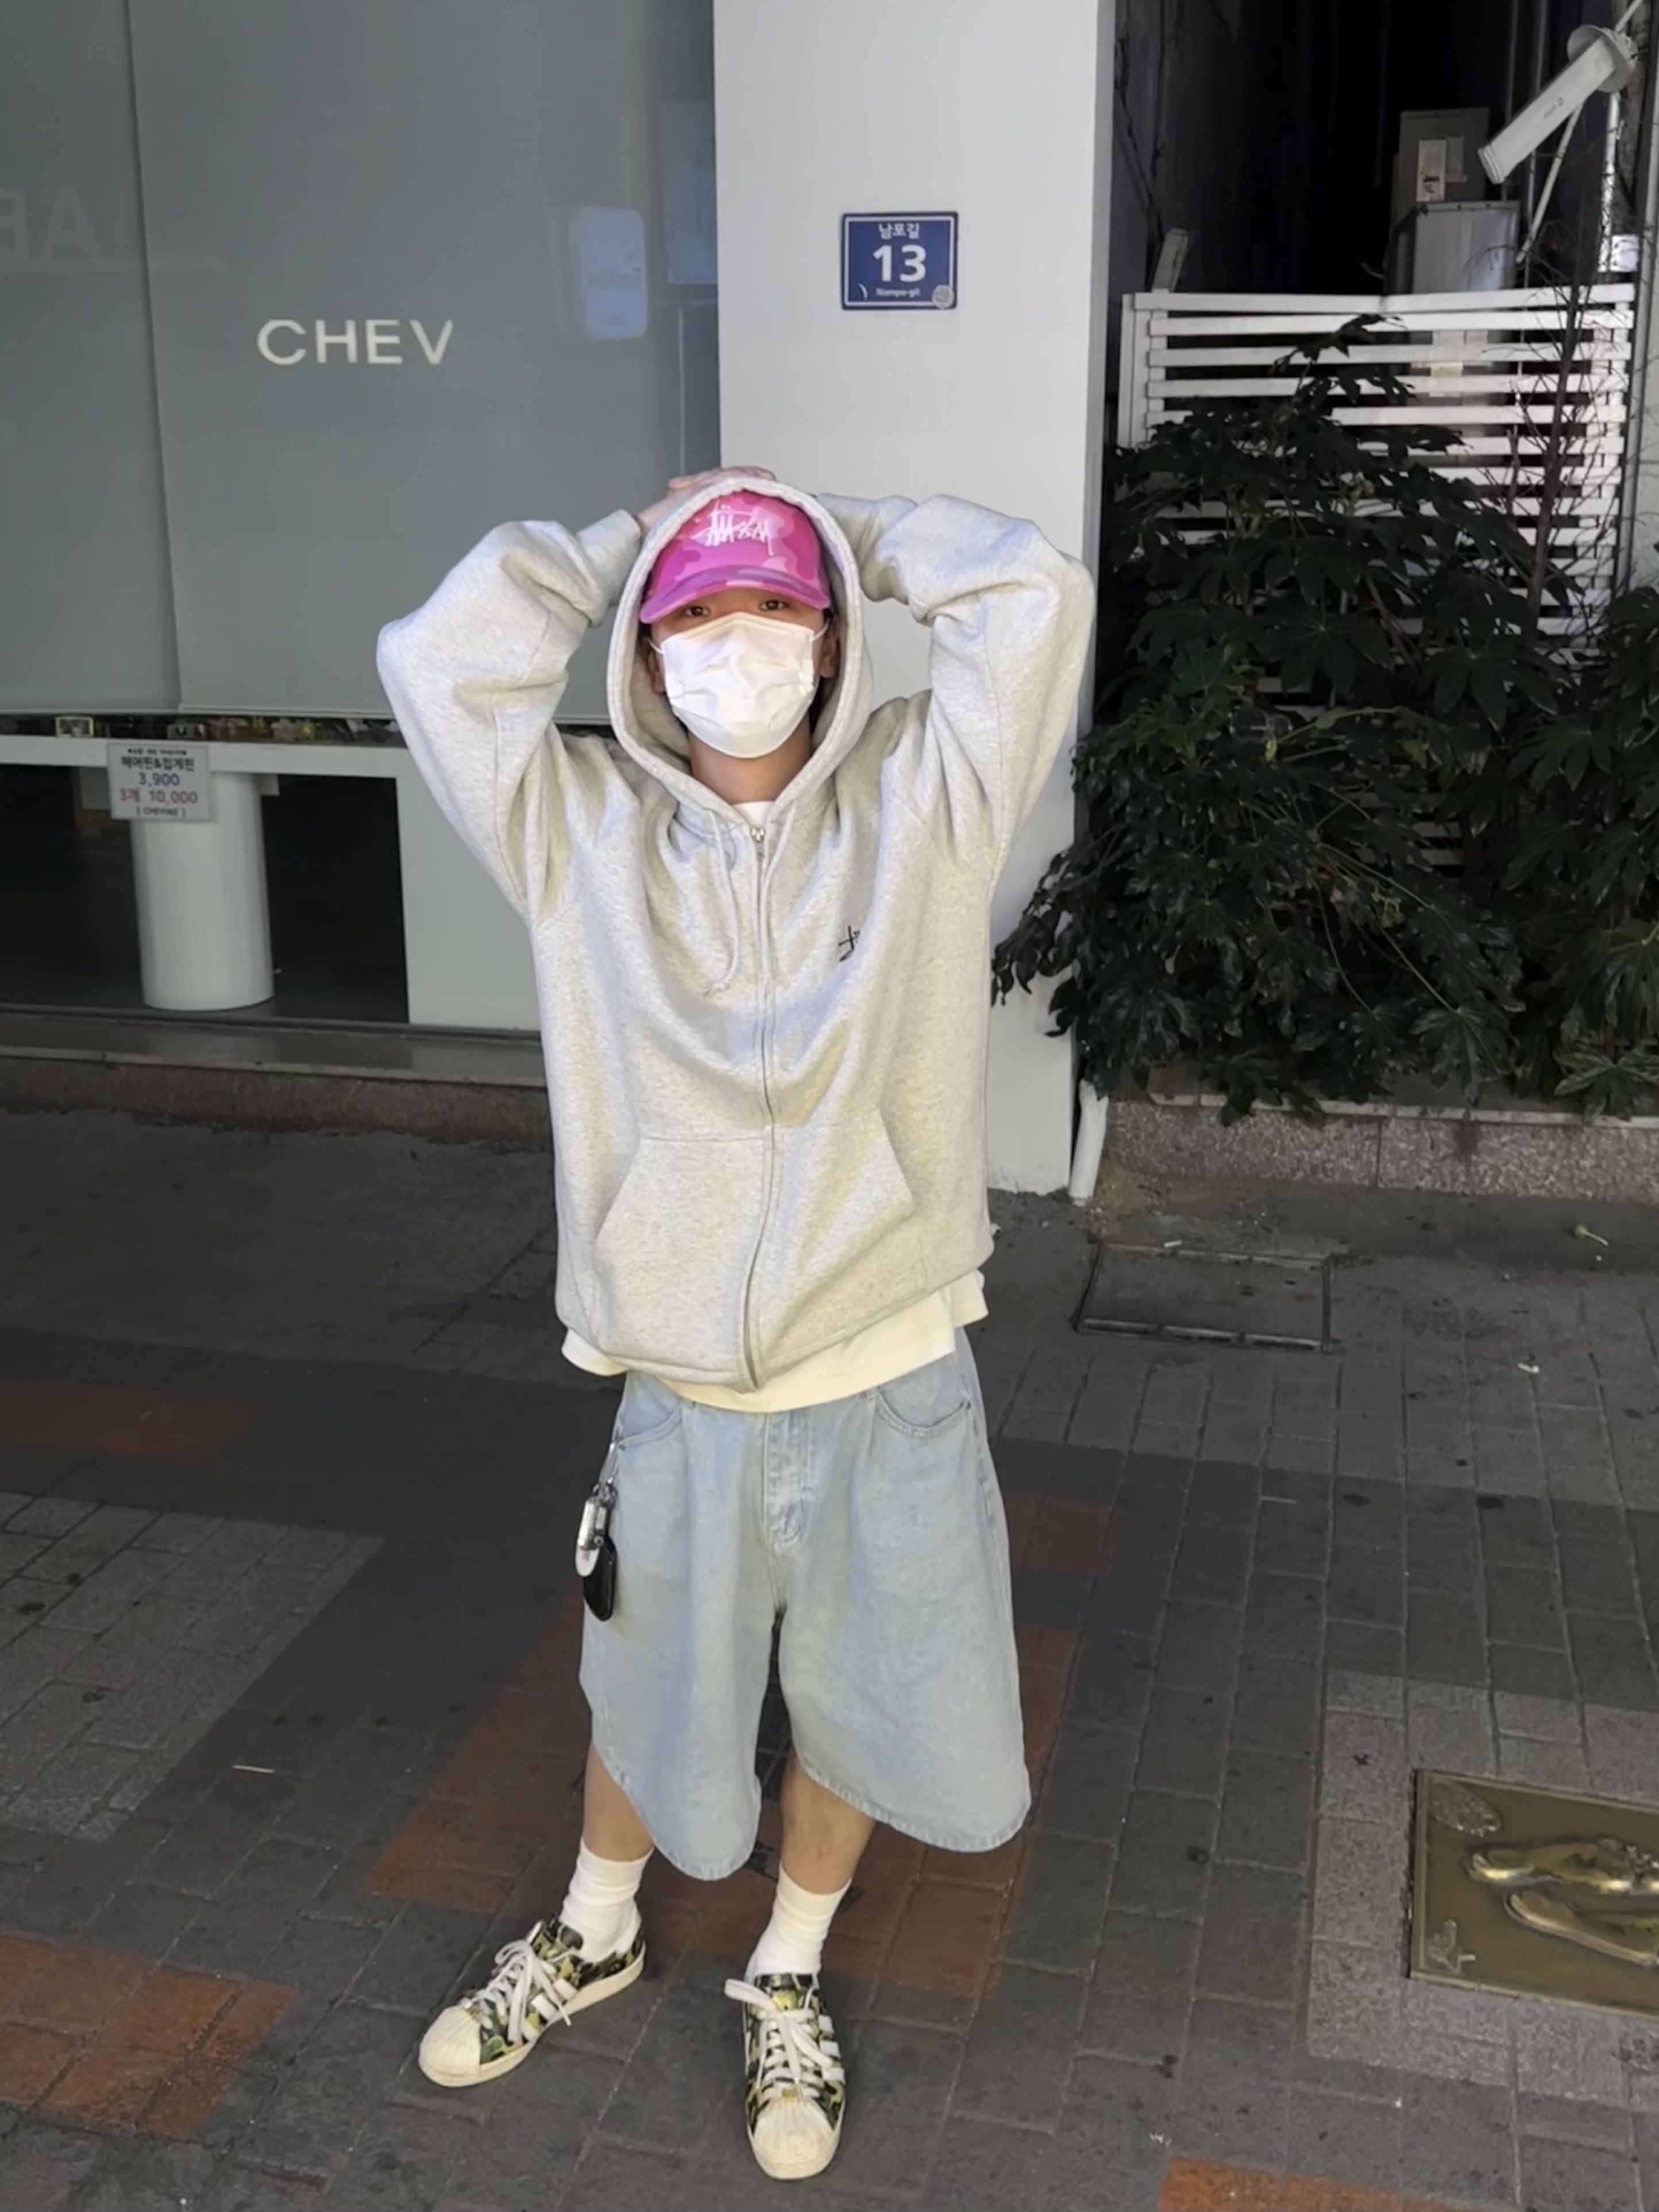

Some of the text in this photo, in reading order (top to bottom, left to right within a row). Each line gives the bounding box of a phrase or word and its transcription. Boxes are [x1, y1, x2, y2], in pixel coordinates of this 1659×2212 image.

[878, 222, 920, 240] 남포길
[873, 244, 927, 283] 13
[256, 319, 454, 366] CHEV
[138, 773, 180, 787] 3,900
[119, 788, 198, 805] 3개 10,000
